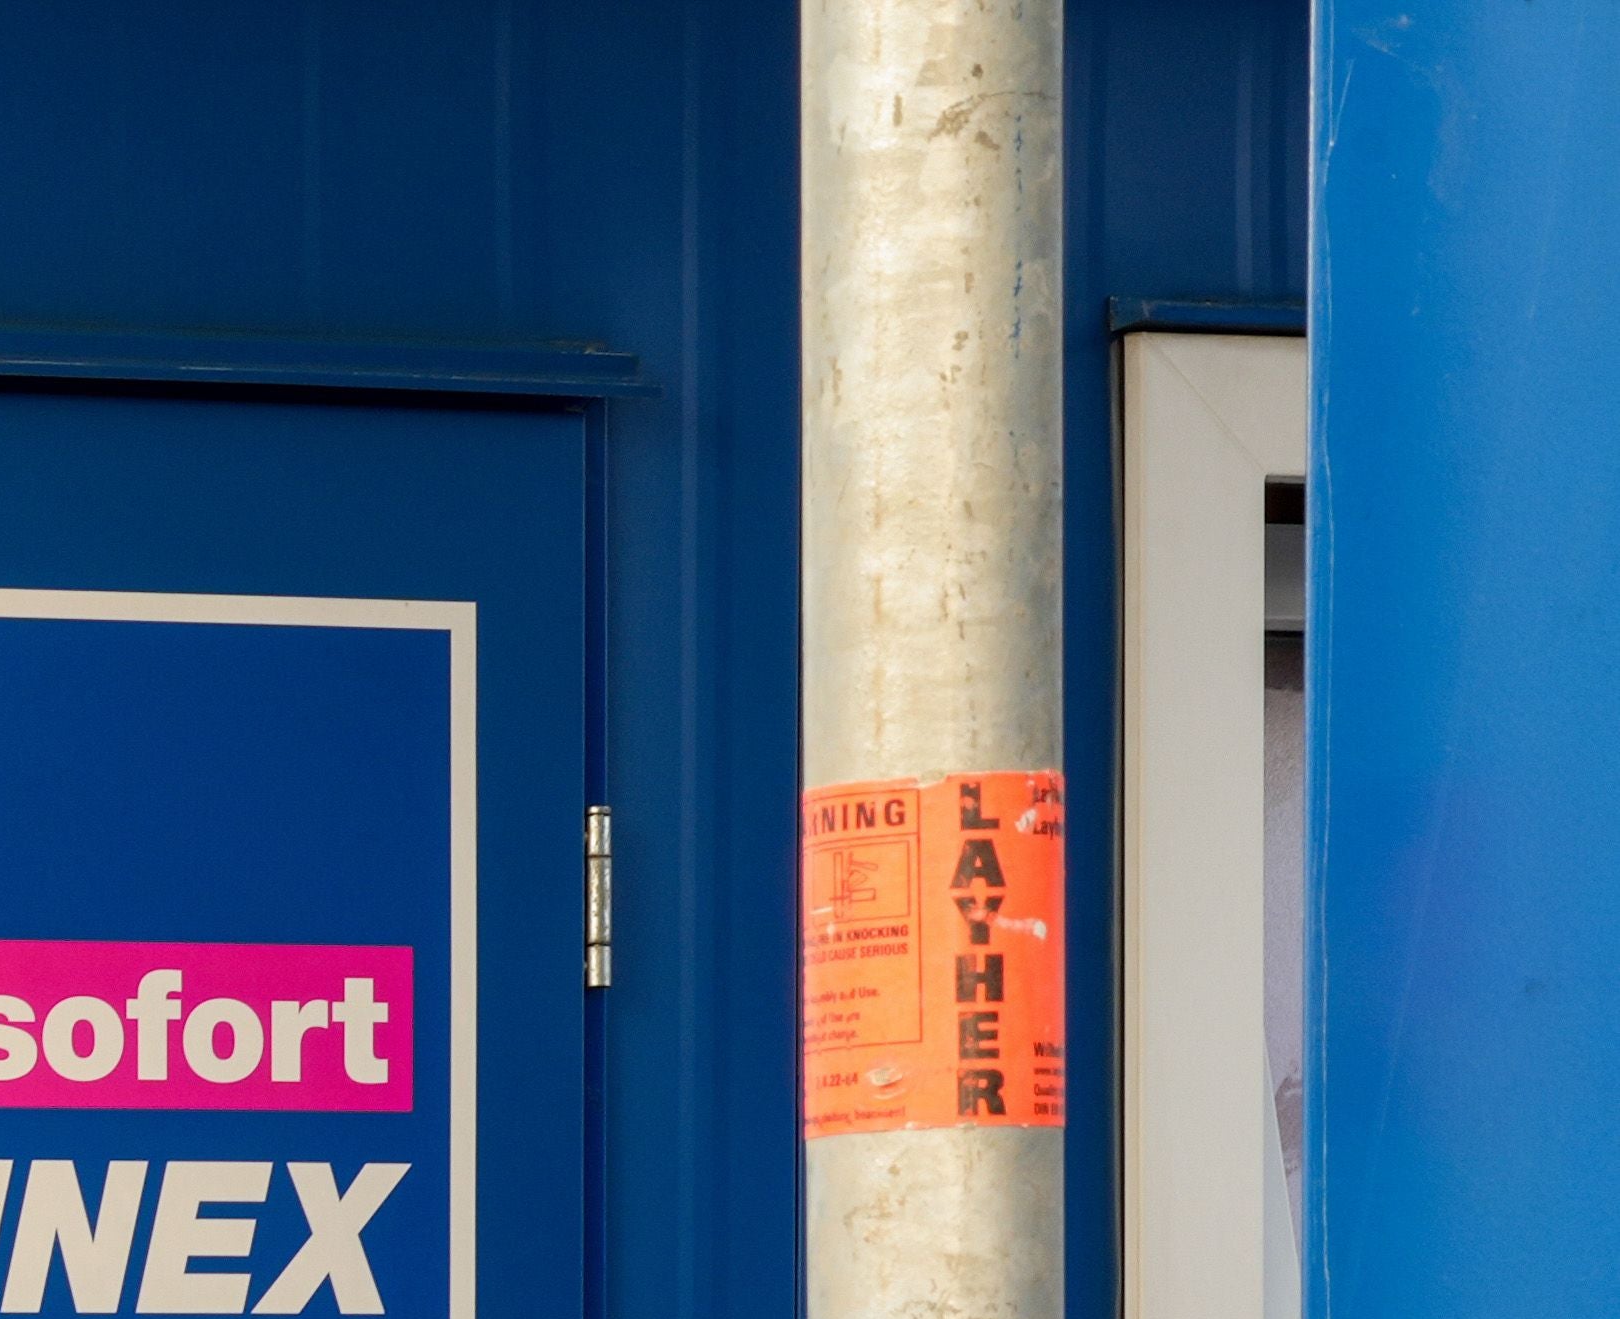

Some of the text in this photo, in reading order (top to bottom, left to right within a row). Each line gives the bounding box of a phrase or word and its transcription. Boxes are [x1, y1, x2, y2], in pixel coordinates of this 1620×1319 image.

[846, 924, 909, 941] KNOCKING
[860, 942, 909, 959] SERIOUS
[949, 781, 1007, 1117] LAYHER
